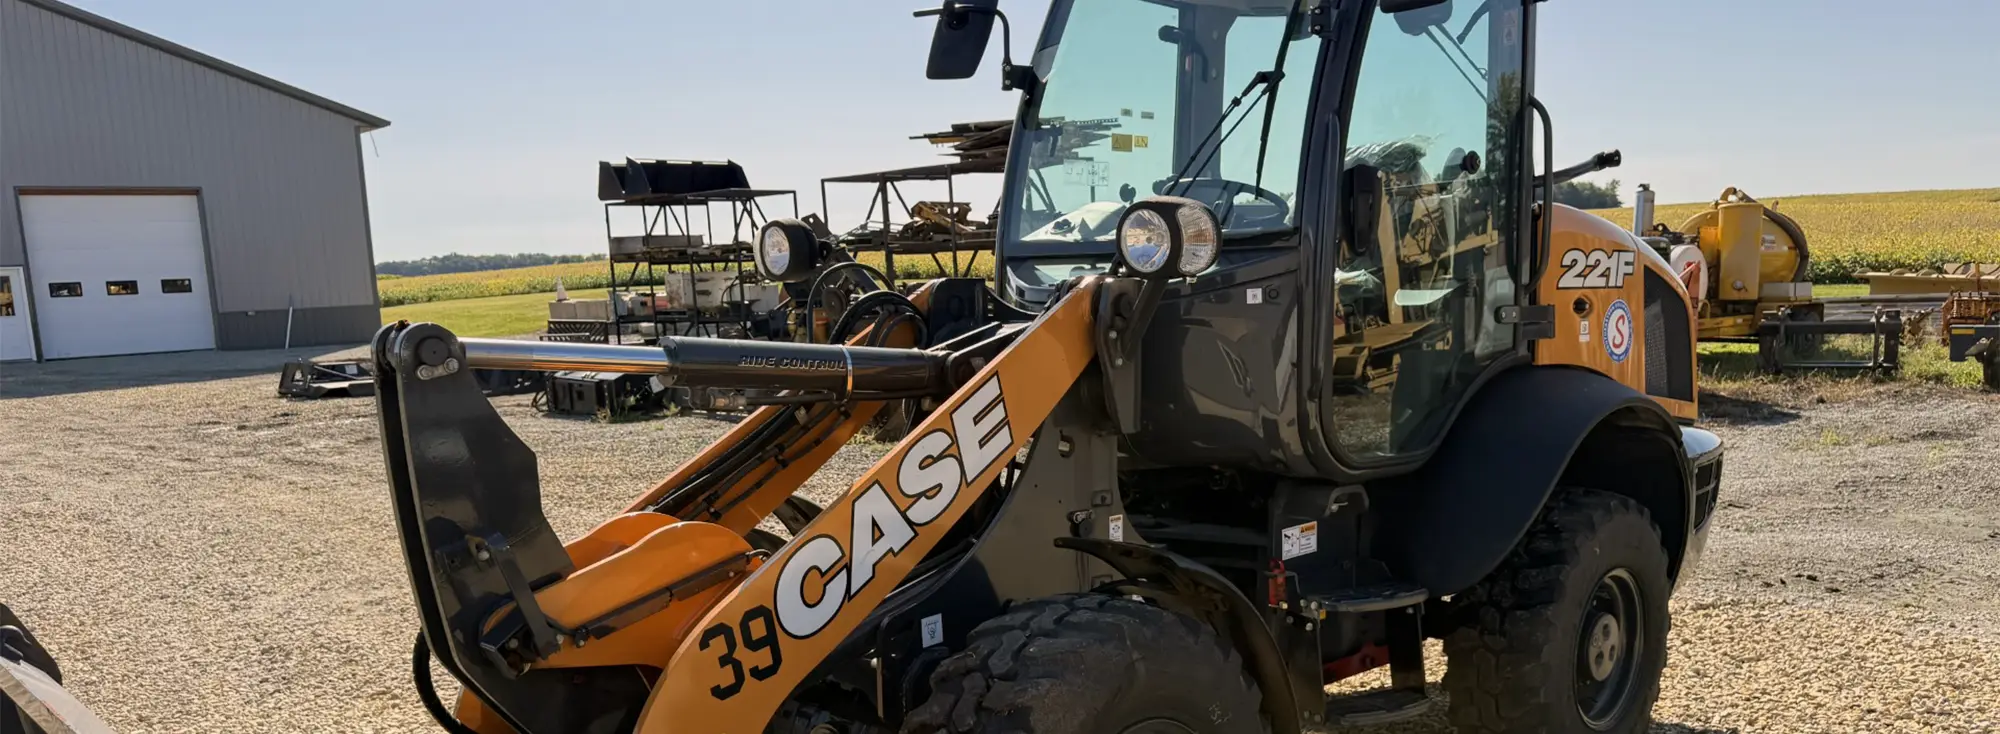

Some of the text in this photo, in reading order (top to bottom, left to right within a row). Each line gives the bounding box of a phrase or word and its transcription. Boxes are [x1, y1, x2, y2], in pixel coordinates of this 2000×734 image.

[1557, 248, 1635, 289] 221F
[738, 355, 847, 371] RIDE CONTROL
[774, 371, 1014, 640] CASE
[699, 604, 783, 701] 39
